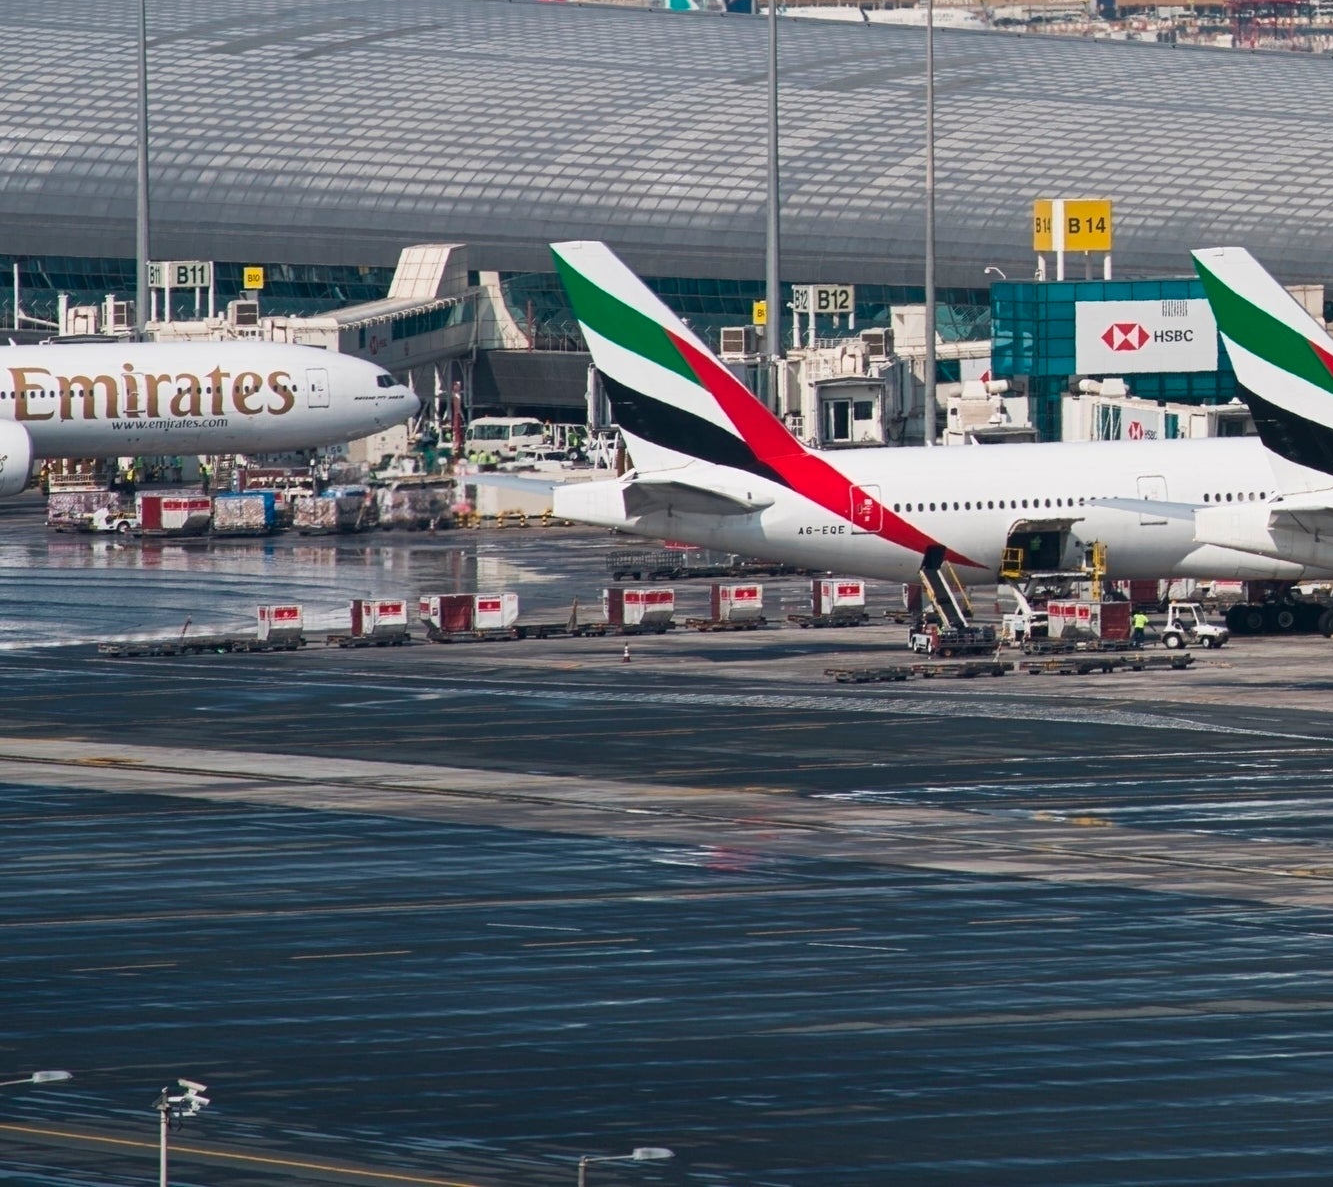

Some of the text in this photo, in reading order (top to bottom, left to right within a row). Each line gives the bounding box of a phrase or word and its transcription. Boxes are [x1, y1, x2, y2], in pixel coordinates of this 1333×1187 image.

[1068, 217, 1106, 233] B 14
[150, 266, 160, 284] B11
[177, 266, 204, 285] B11
[795, 289, 808, 309] B12
[818, 289, 849, 309] B12
[1154, 330, 1193, 342] HSBC
[7, 363, 296, 421] Emirates
[112, 417, 228, 431] www.emirates.com
[798, 525, 846, 535] A6-EQE
